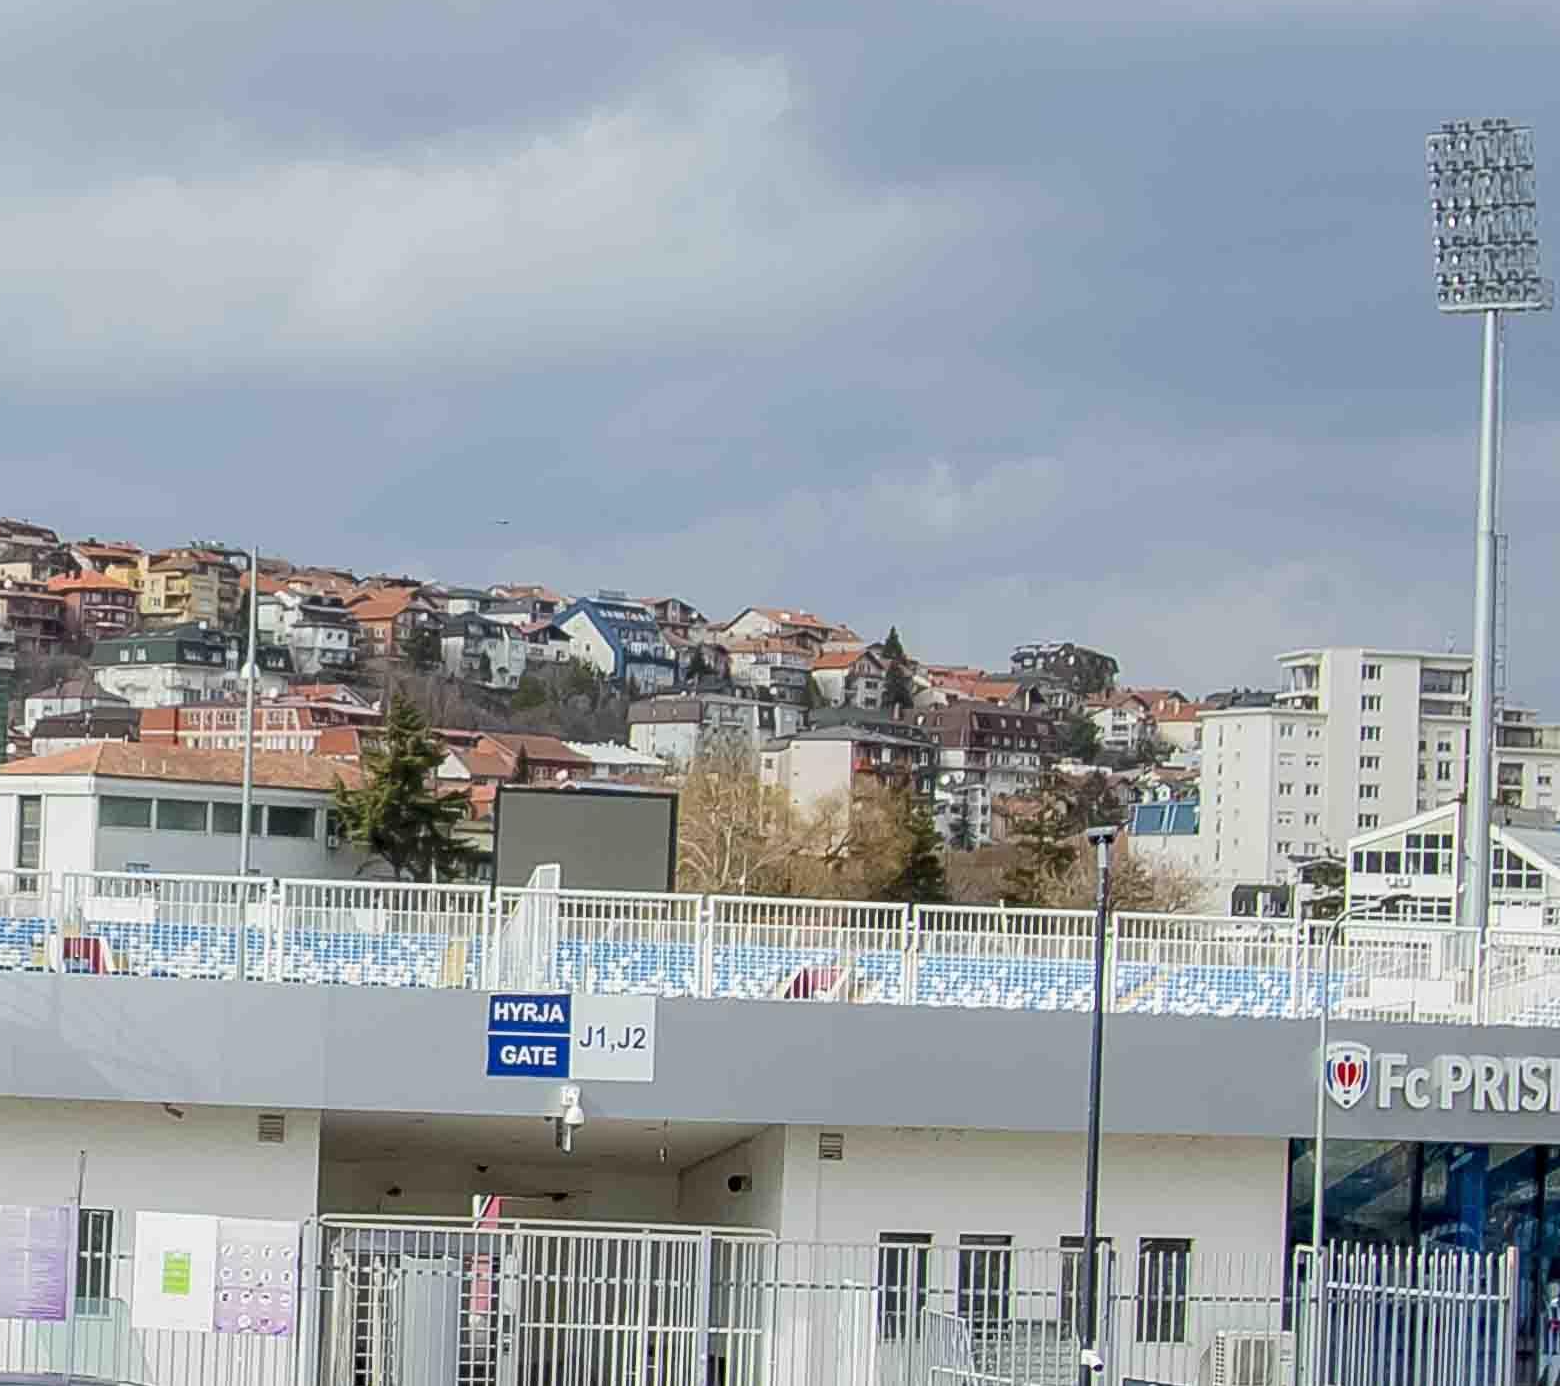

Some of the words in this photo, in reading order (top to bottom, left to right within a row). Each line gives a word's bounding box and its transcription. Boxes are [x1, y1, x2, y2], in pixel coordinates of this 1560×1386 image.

[494, 1002, 565, 1023] HYRJA
[579, 1025, 647, 1053] J1,J2
[500, 1045, 557, 1066] GATE
